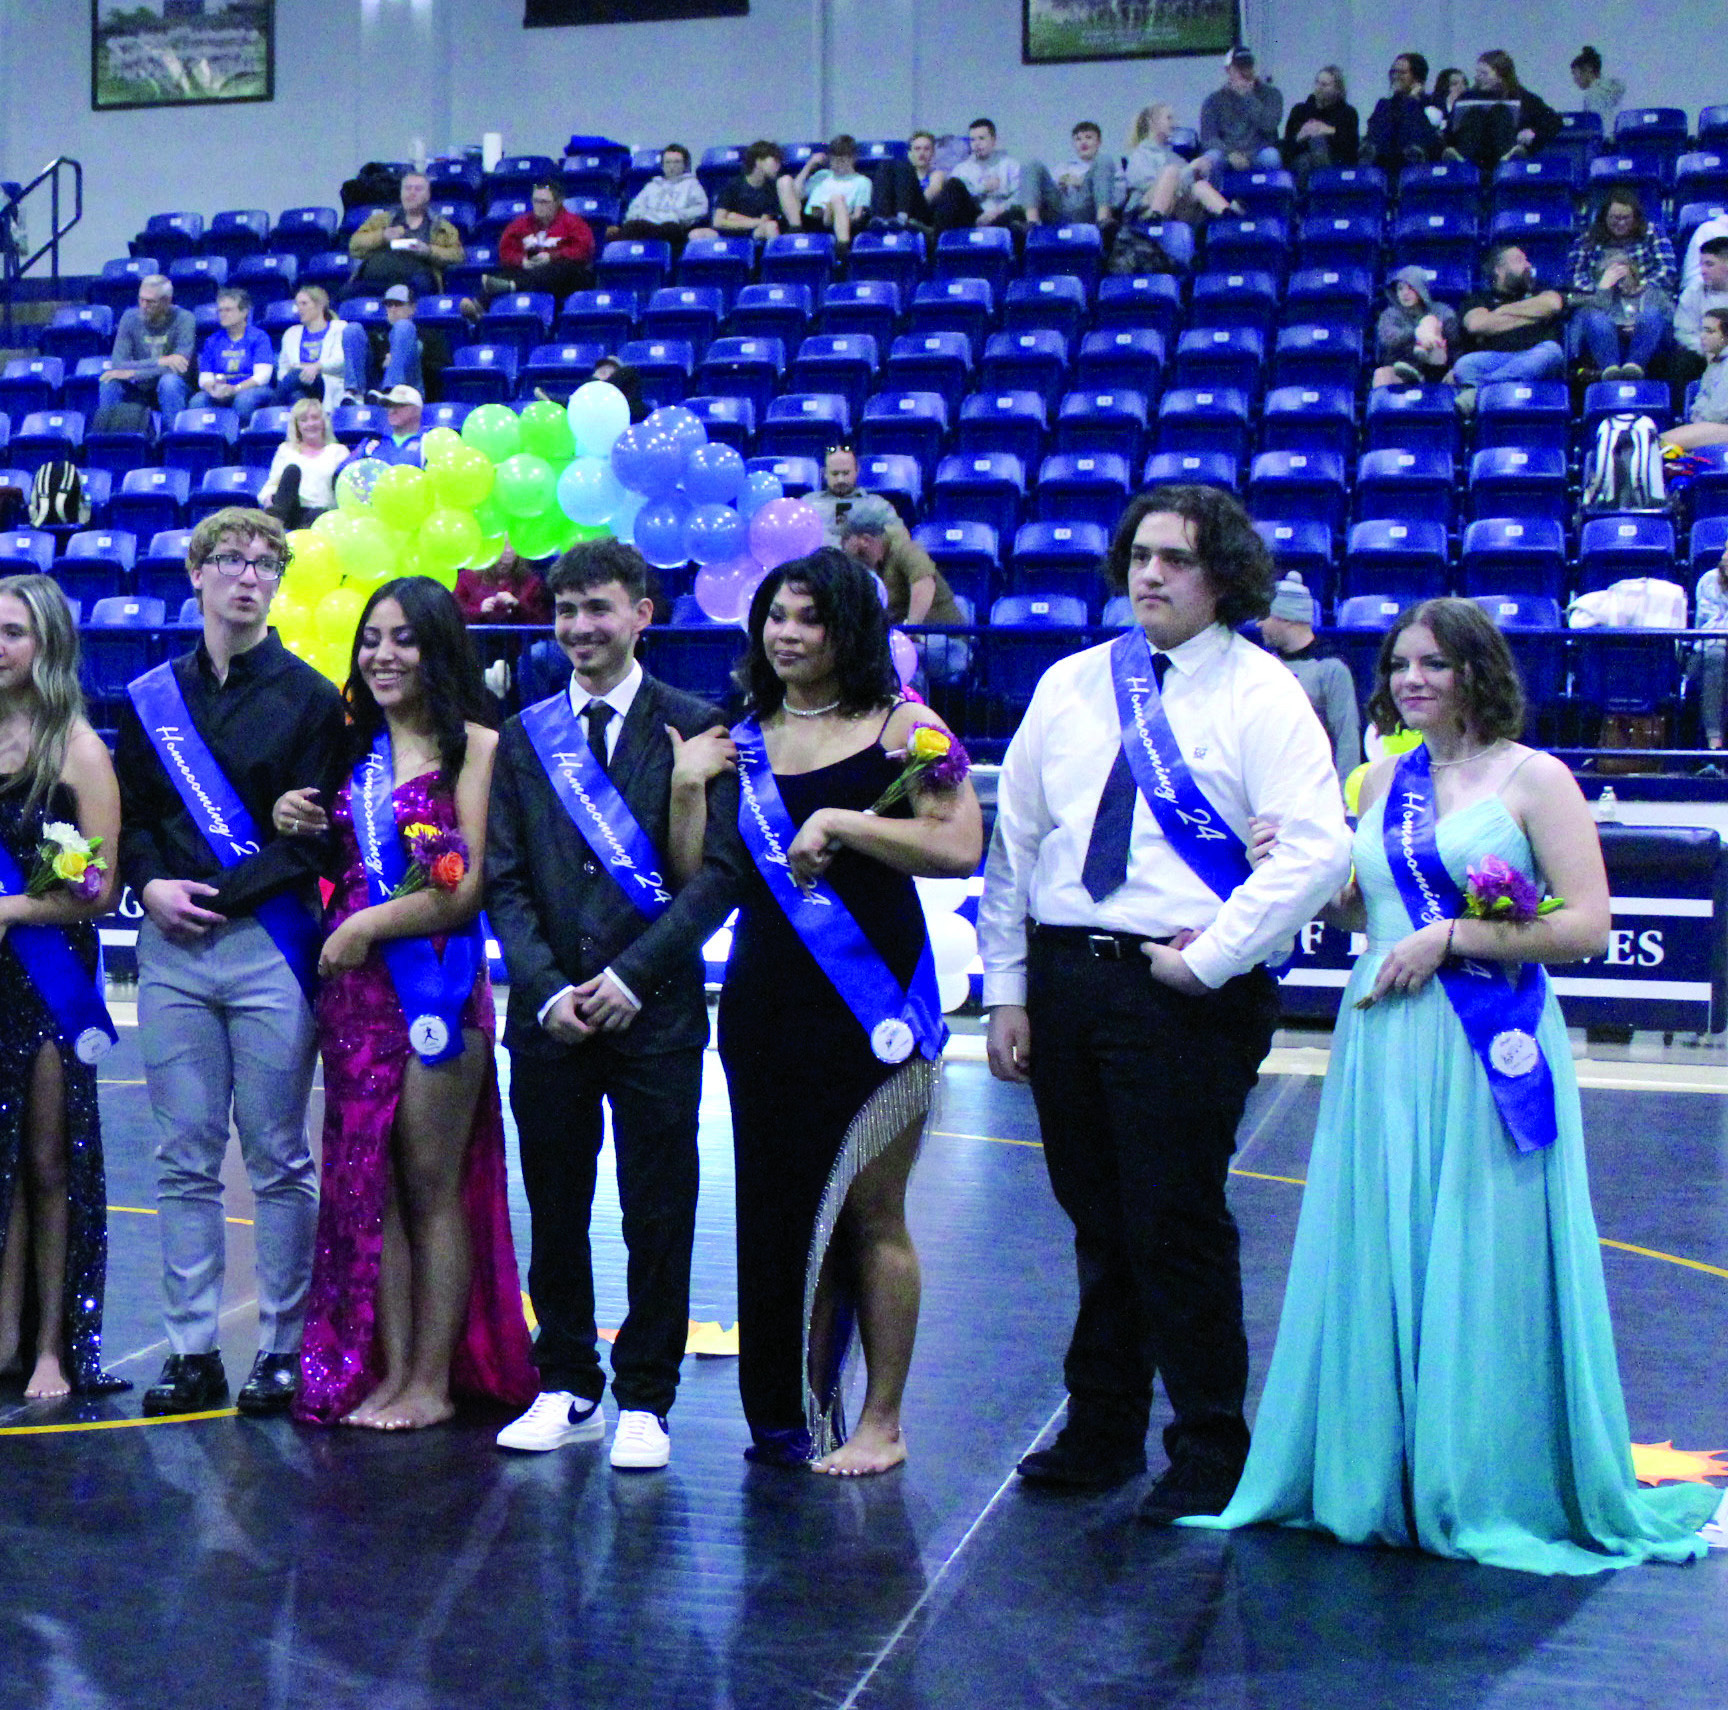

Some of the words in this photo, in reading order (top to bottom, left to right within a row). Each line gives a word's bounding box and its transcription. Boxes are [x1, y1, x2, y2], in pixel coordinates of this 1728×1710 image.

[155, 725, 234, 838] Homecoming
[363, 751, 384, 876] Homecoming
[736, 749, 791, 868] Homecoming
[1126, 676, 1180, 804] Homecoming
[1175, 807, 1228, 841] 24
[551, 752, 638, 870] Homecoming
[633, 871, 672, 904] 24
